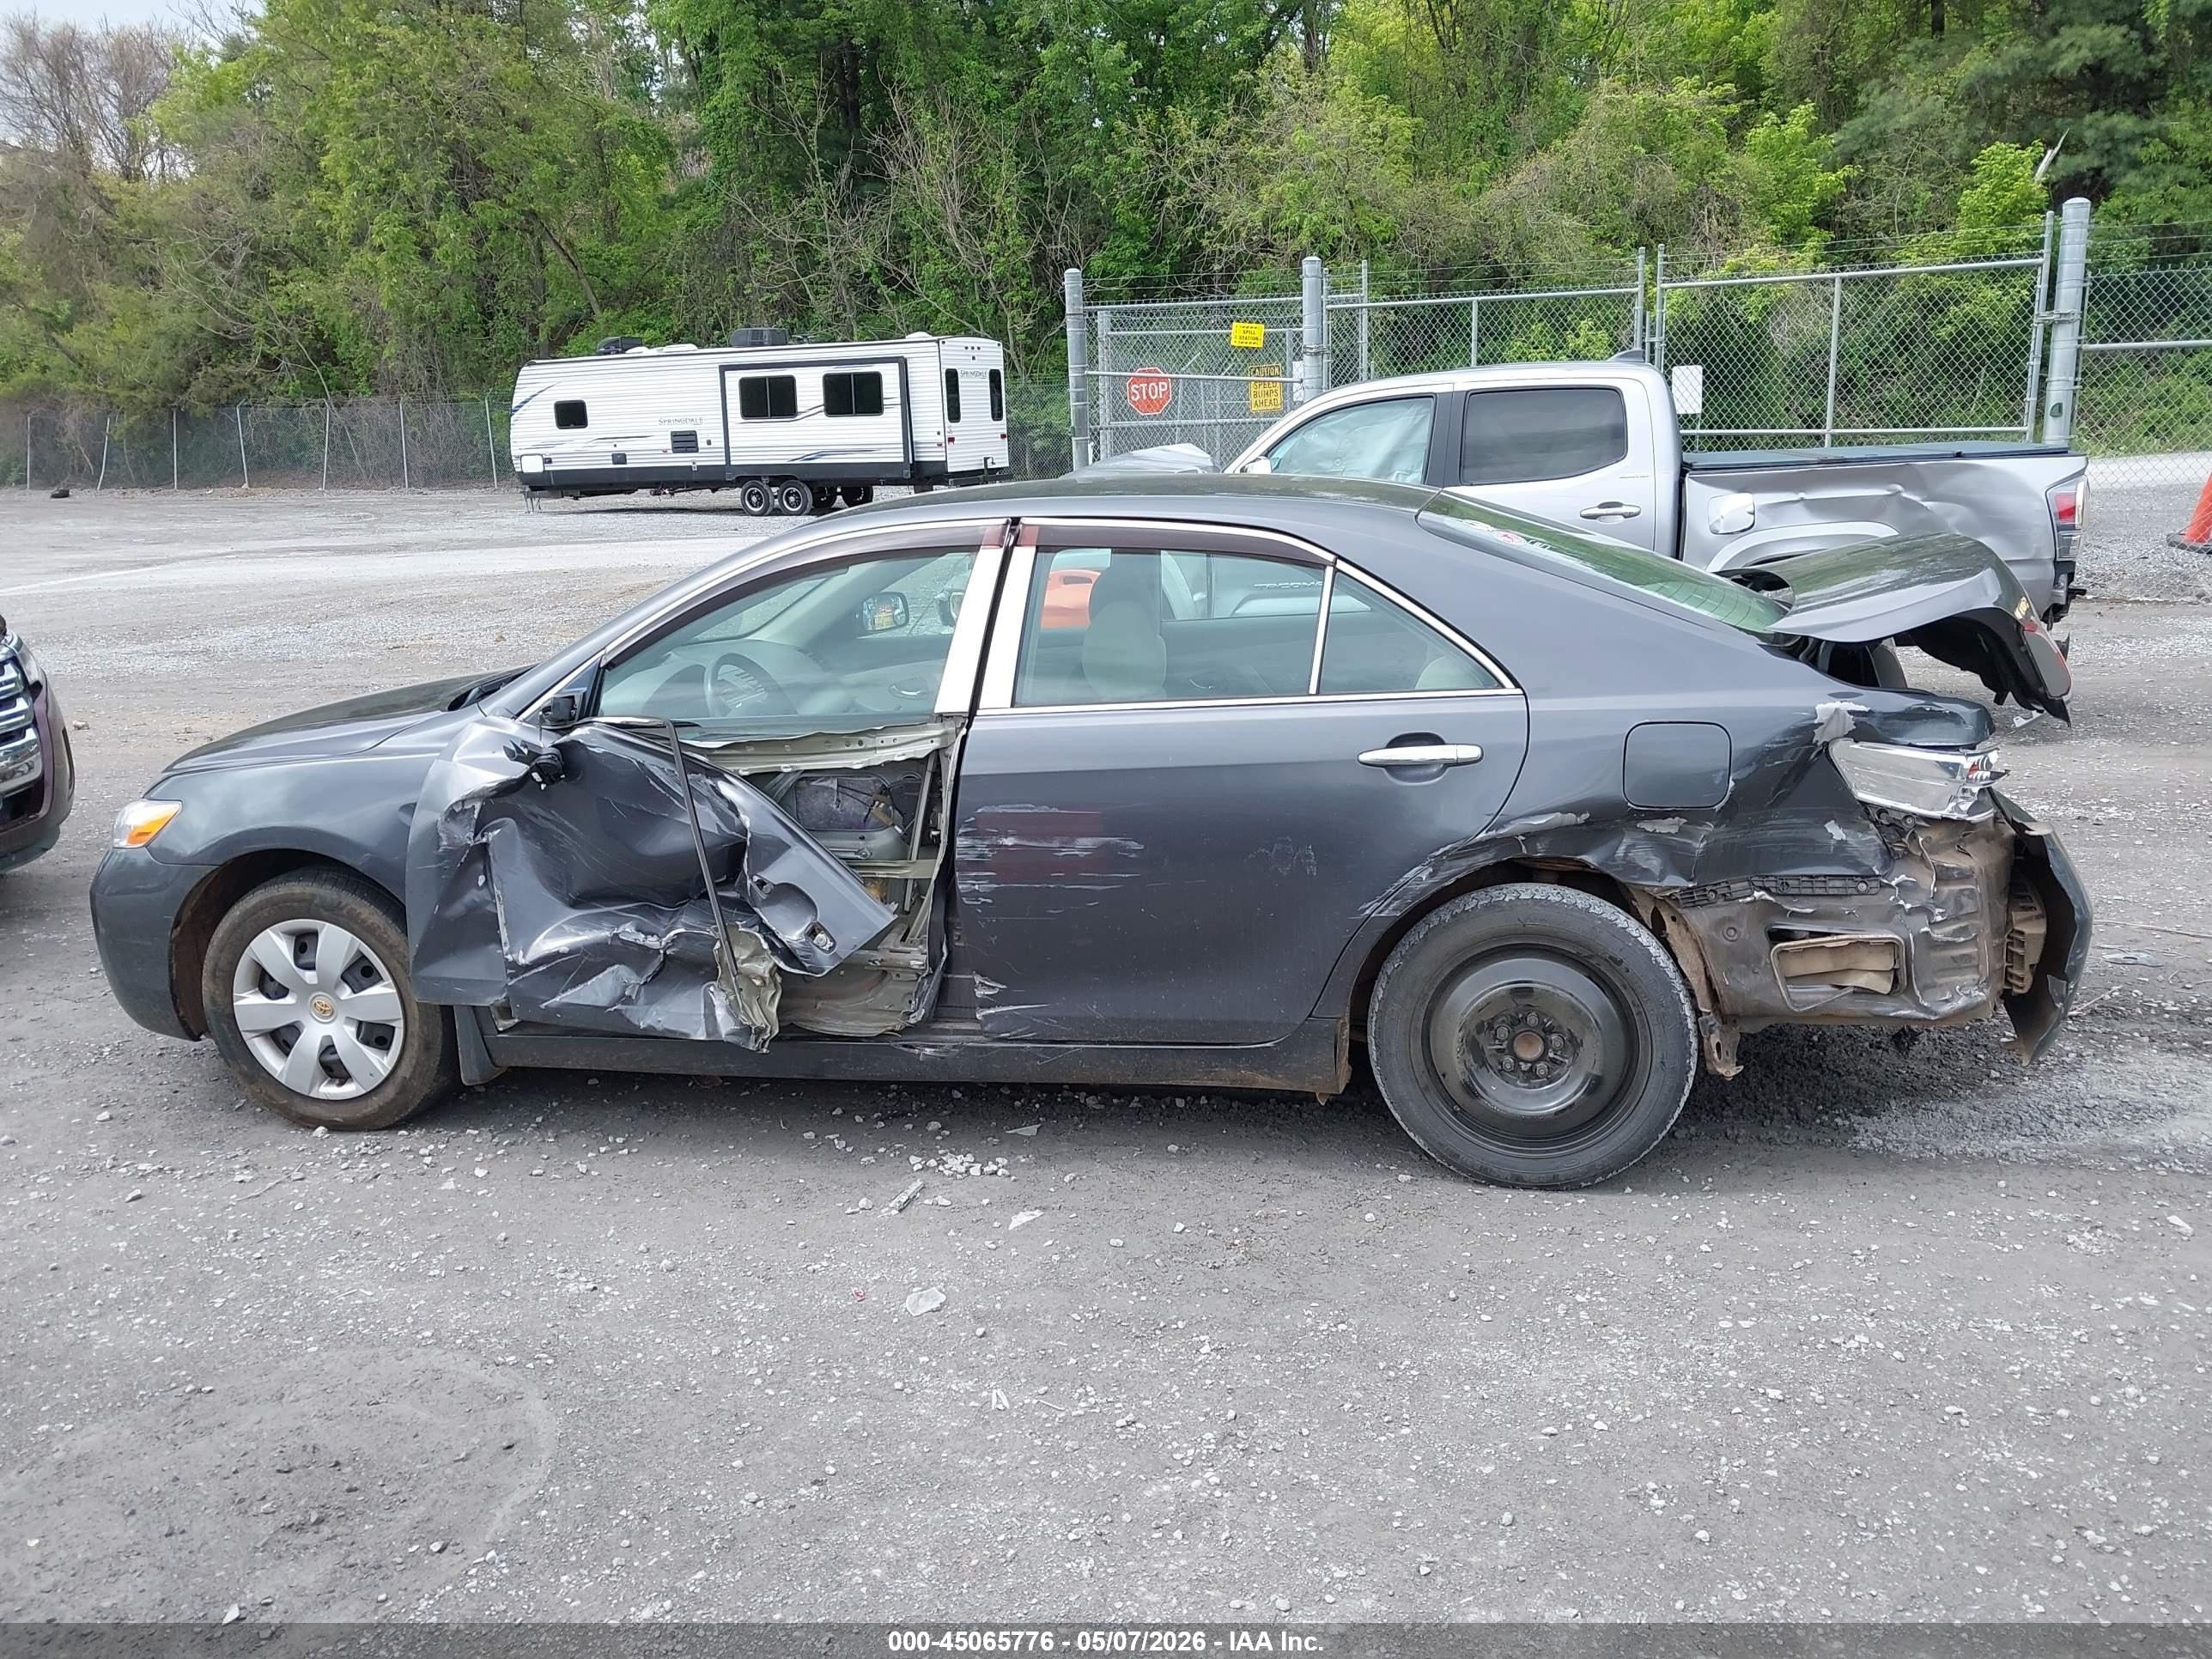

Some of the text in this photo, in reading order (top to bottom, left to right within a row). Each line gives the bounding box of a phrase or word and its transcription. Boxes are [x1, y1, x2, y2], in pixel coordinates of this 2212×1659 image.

[1249, 365, 1280, 378] CAUTION
[1253, 380, 1278, 390] SPEED
[1130, 381, 1168, 402] STOP
[1253, 389, 1279, 399] BUMPS
[1254, 398, 1279, 408] AHEAD
[658, 416, 704, 426] SPRINGDALE
